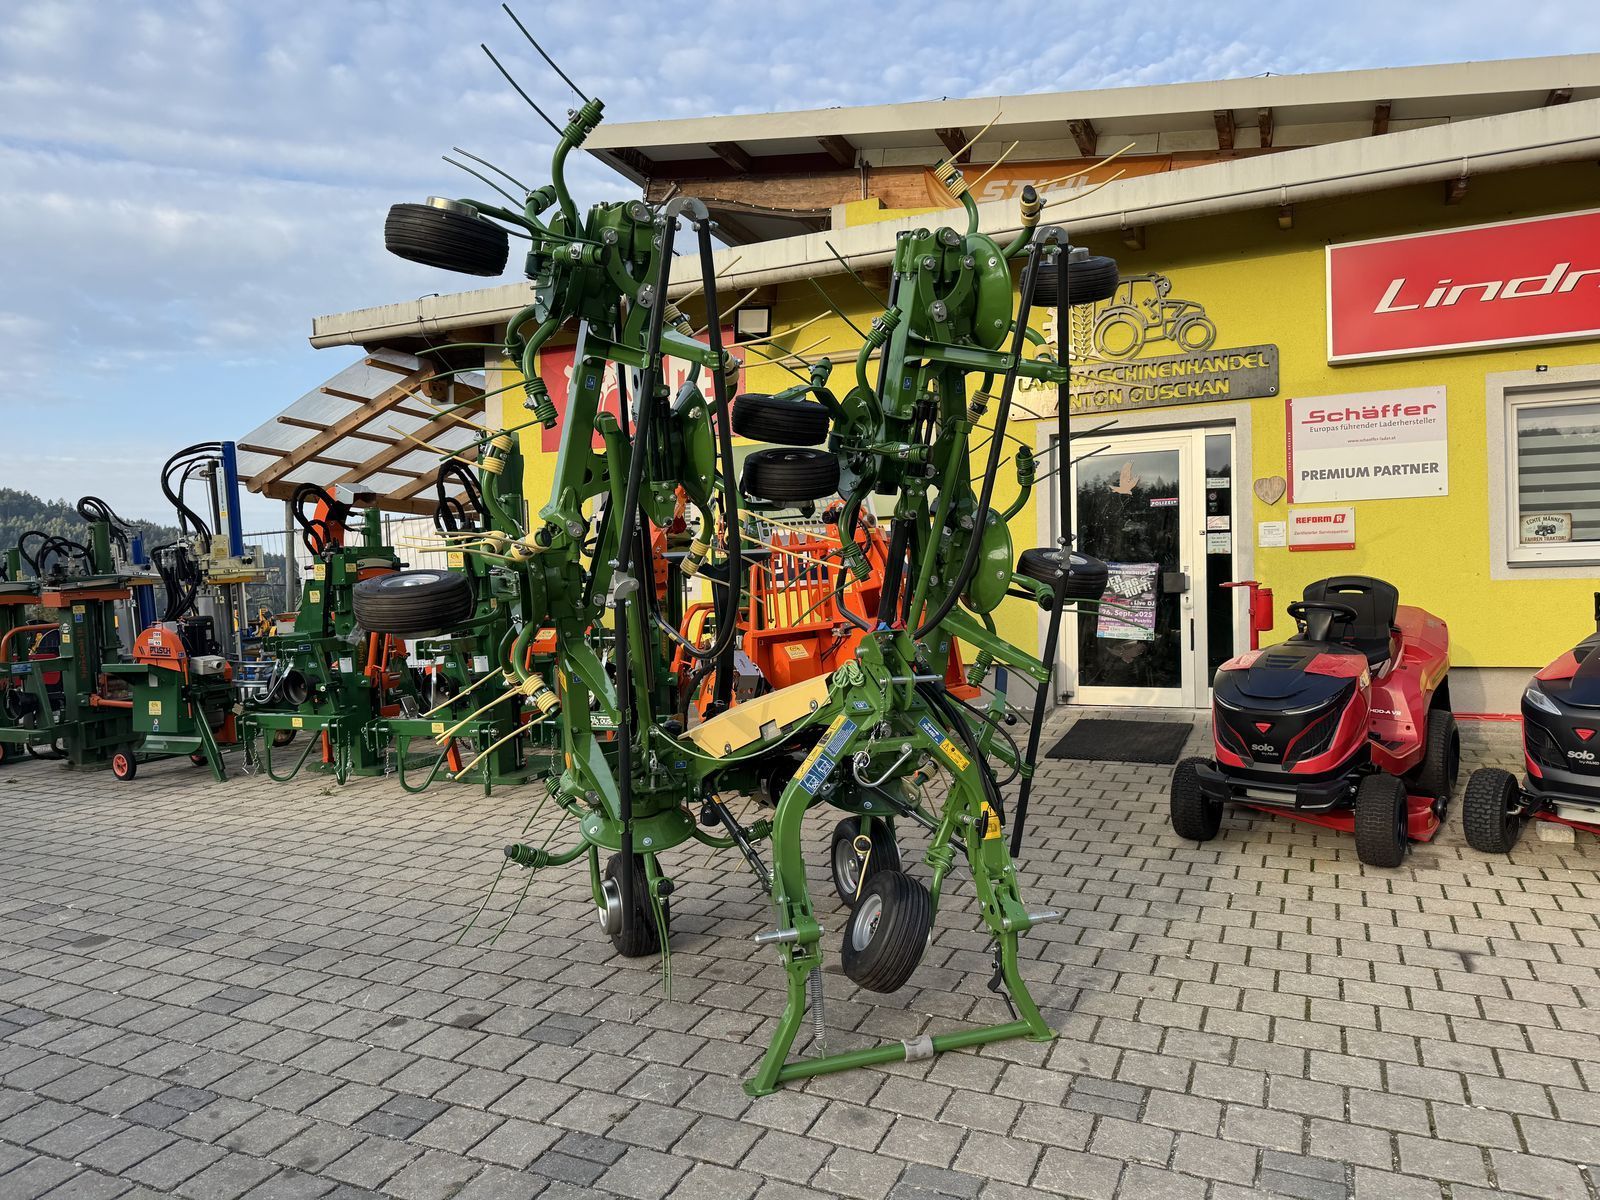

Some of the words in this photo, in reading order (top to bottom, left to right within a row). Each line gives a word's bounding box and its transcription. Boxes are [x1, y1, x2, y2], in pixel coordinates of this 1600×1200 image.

[1301, 403, 1437, 424] Schäffer
[1309, 425, 1339, 433] Europas
[1340, 421, 1378, 431] führender
[1379, 417, 1436, 428] Laderhersteller
[1301, 466, 1370, 481] PREMIUM
[1373, 462, 1439, 477] PARTNER
[1295, 515, 1332, 524] REFORM
[1526, 516, 1541, 525] ECHTE
[1113, 577, 1139, 593] BERG
[1124, 582, 1152, 599] RUFT!
[1114, 610, 1133, 618] Sept.
[1251, 743, 1274, 752] solo
[1567, 750, 1595, 760] solo
